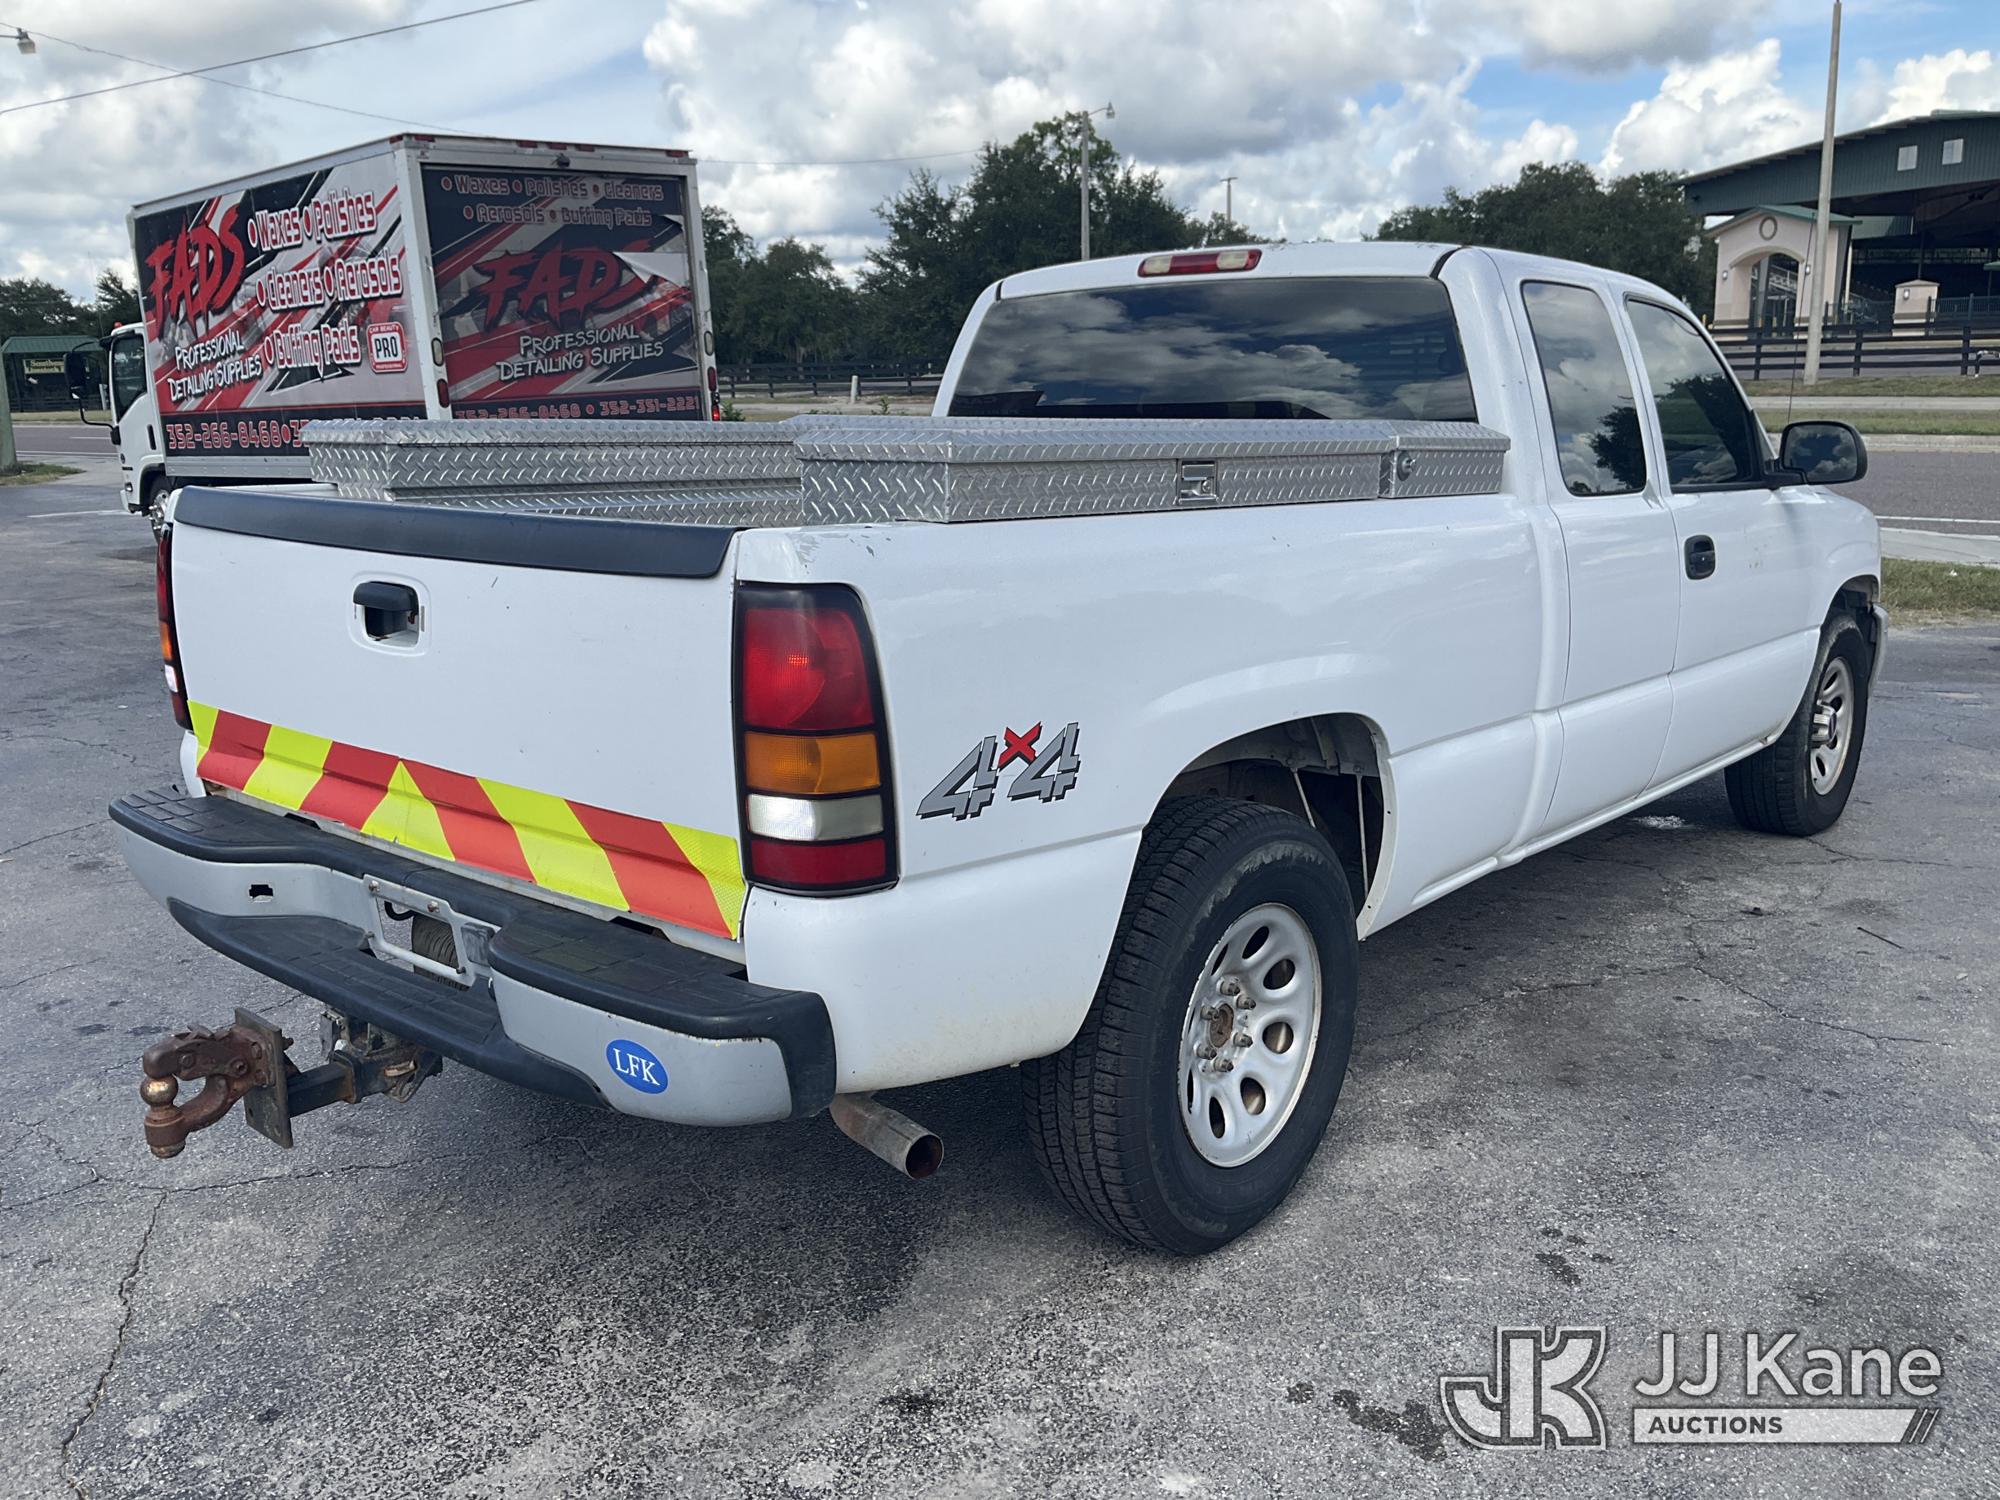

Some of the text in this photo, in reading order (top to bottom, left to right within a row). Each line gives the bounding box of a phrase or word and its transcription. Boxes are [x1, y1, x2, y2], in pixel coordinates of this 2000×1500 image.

[453, 174, 664, 200] Waxes Polishes Cleaners
[256, 188, 377, 251] Waxes Polishes
[476, 203, 652, 230] Aerosols Buffing Pads
[146, 204, 245, 336] FADS
[266, 247, 403, 311] Cleaners Aerosols
[175, 329, 245, 371] PROFESSIONAL
[273, 318, 361, 378] Buffing Pads
[374, 336, 399, 359] PRO
[519, 323, 639, 355] PROFESSIONAL
[167, 355, 263, 402] DETAILING SUPPLIES
[496, 341, 664, 381] DETAILING SUPPLIES
[166, 419, 282, 449] 352-266-8468
[613, 1047, 661, 1086] LFK
